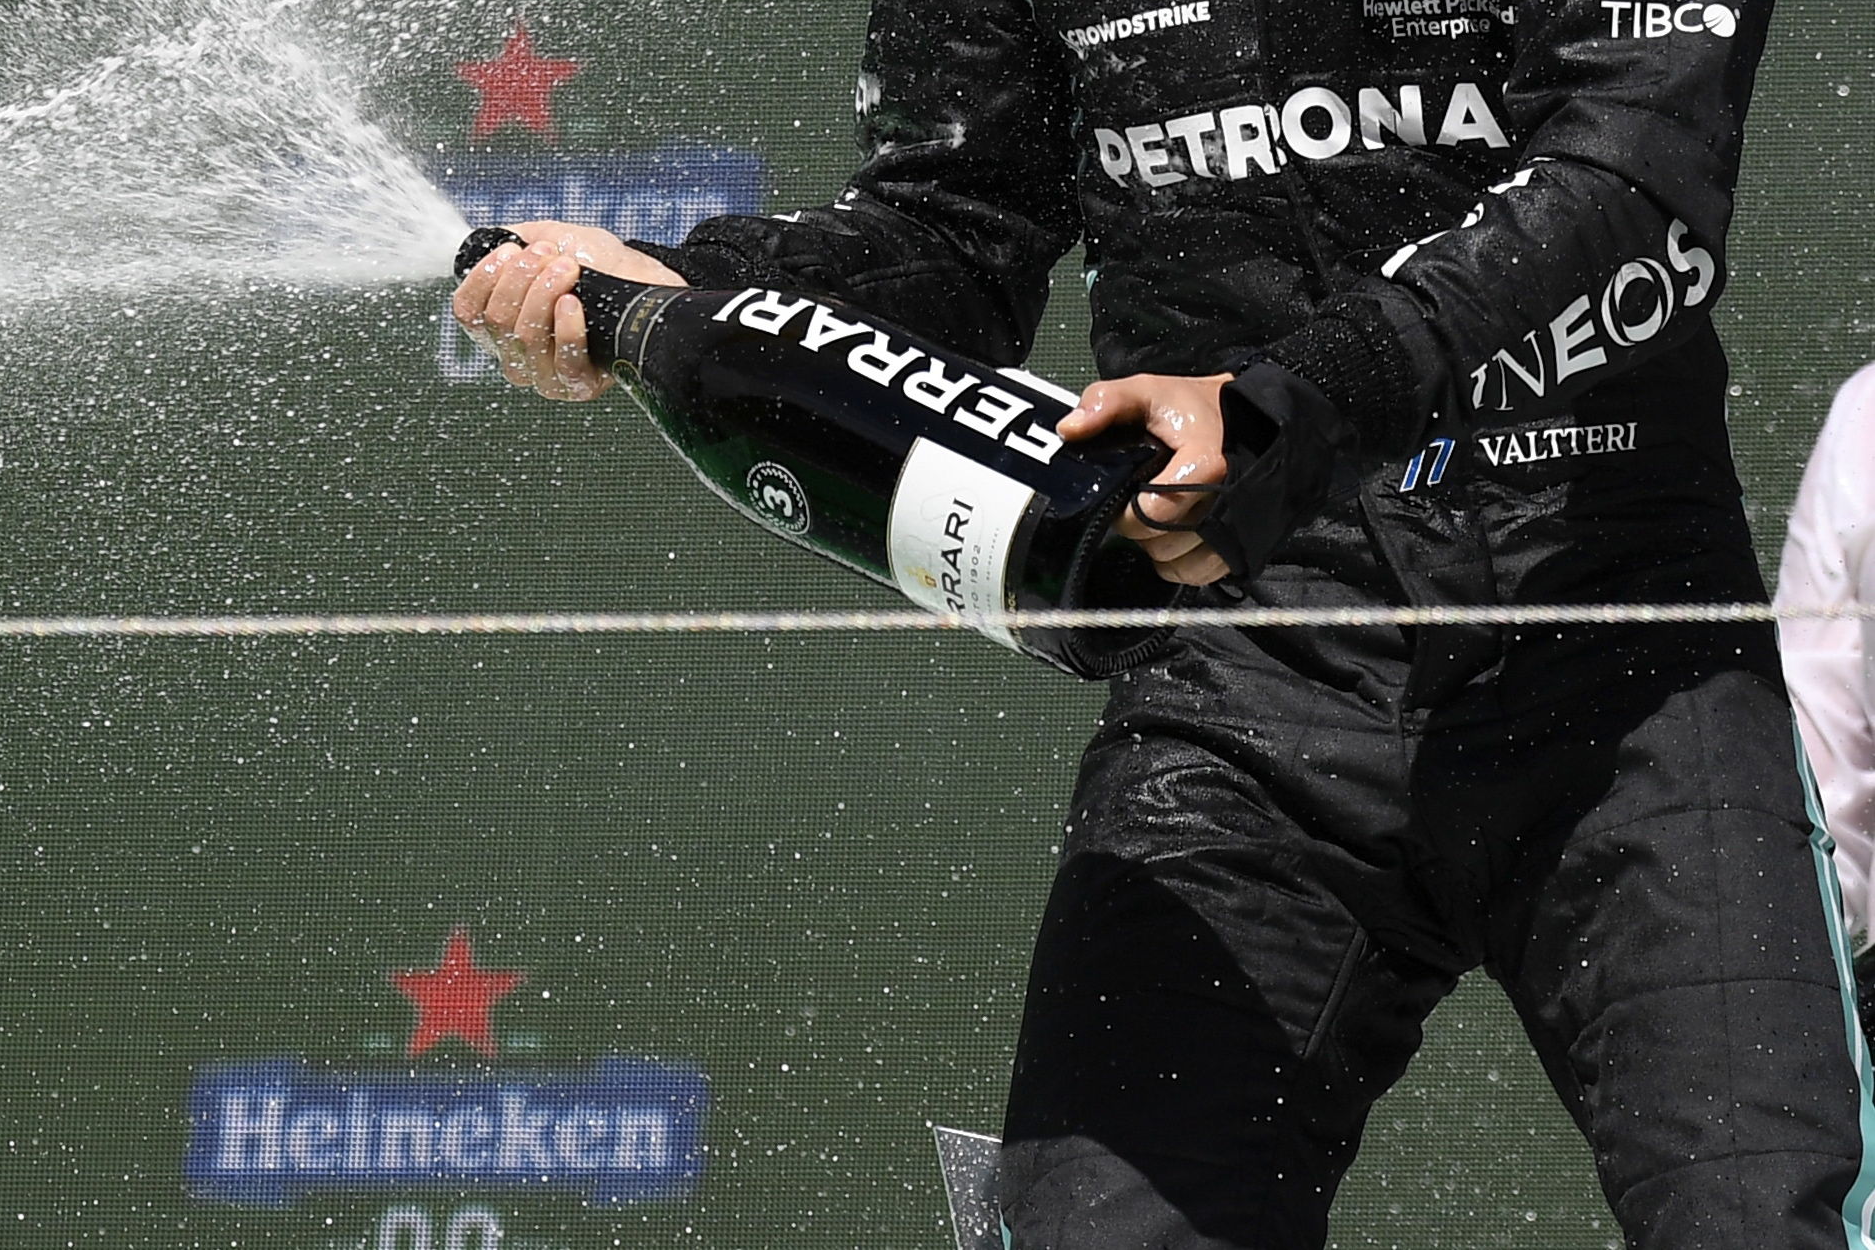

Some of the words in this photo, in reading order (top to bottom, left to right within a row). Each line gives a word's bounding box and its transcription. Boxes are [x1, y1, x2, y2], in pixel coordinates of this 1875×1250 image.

[1066, 1, 1212, 48] CROWDSTRIKE
[1469, 217, 1716, 412] INEOS
[711, 286, 1067, 466] FERRARI
[1478, 421, 1639, 468] VALTTERI
[763, 484, 793, 517] 3
[216, 1085, 671, 1172] Heineken
